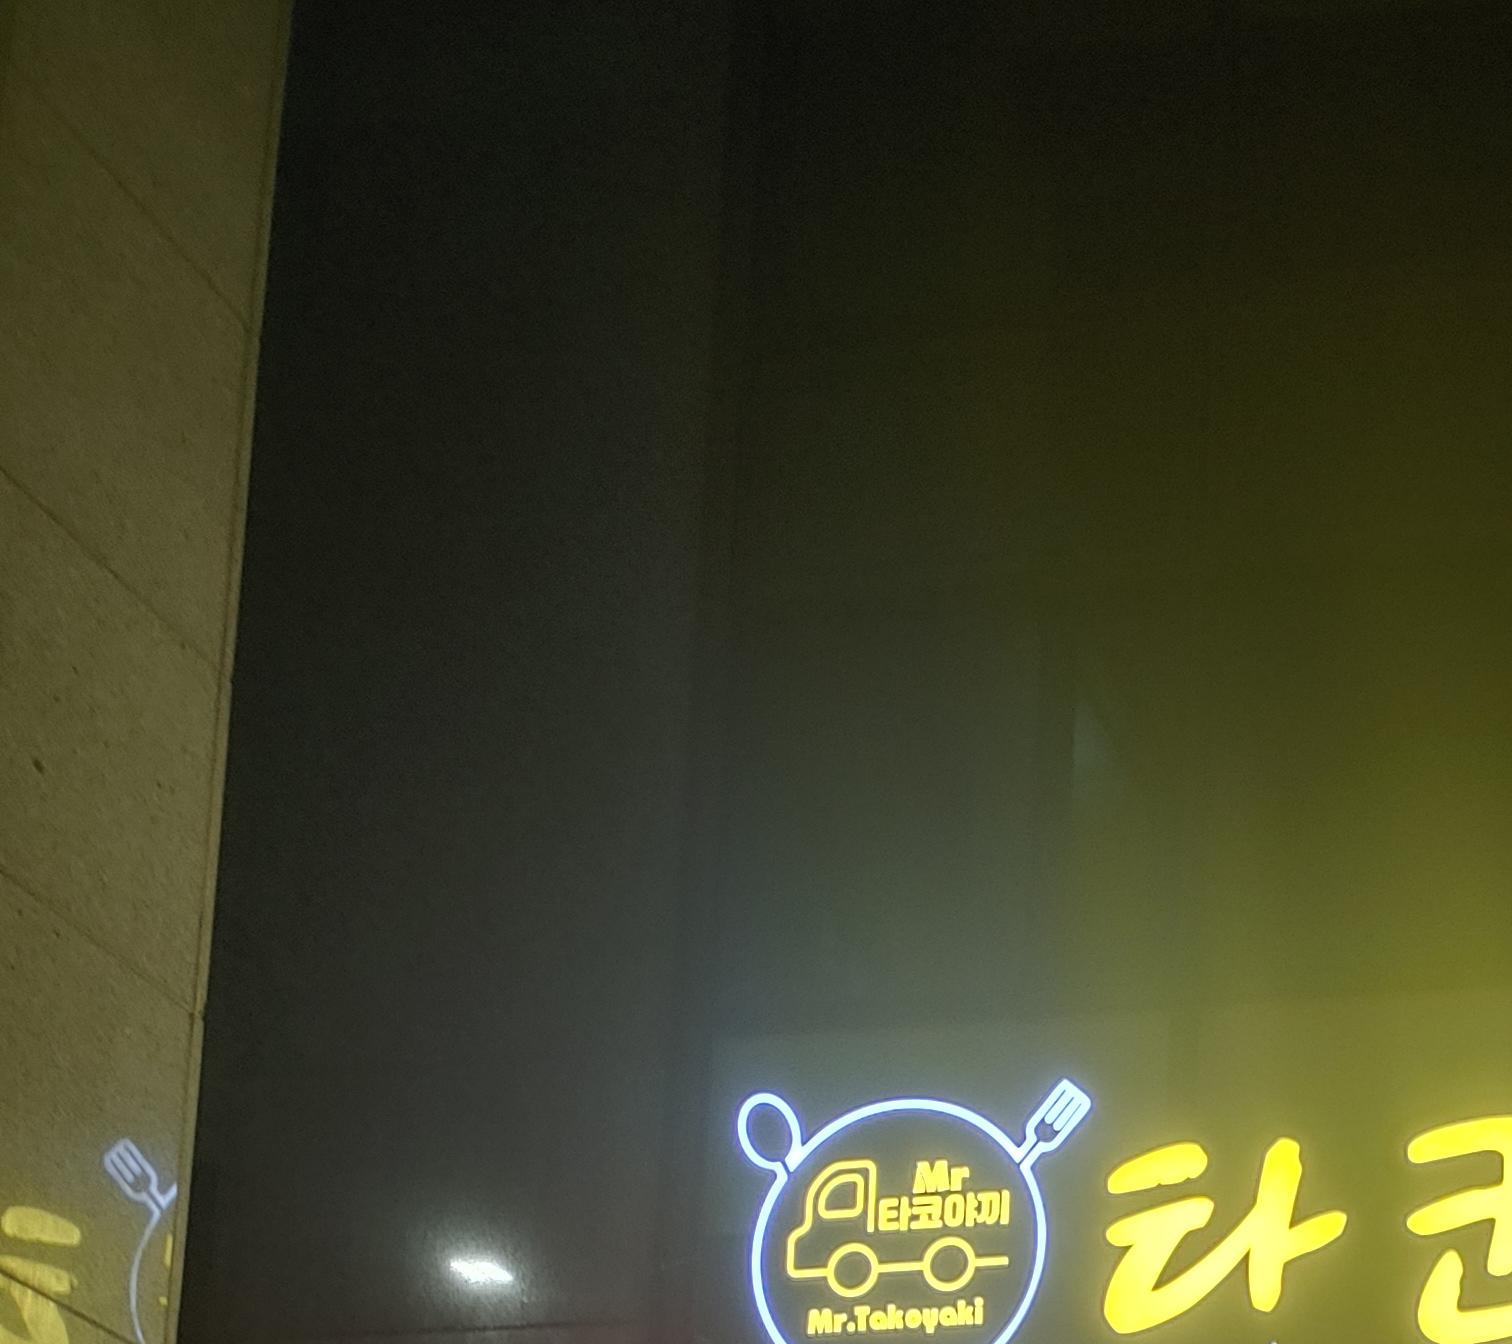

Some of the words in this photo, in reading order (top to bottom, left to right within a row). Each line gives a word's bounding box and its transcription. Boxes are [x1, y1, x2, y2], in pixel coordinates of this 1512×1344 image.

[912, 1160, 969, 1194] Mr
[878, 1189, 1010, 1233] 타코야끼
[807, 1296, 984, 1336] Mr.Takoyaki
